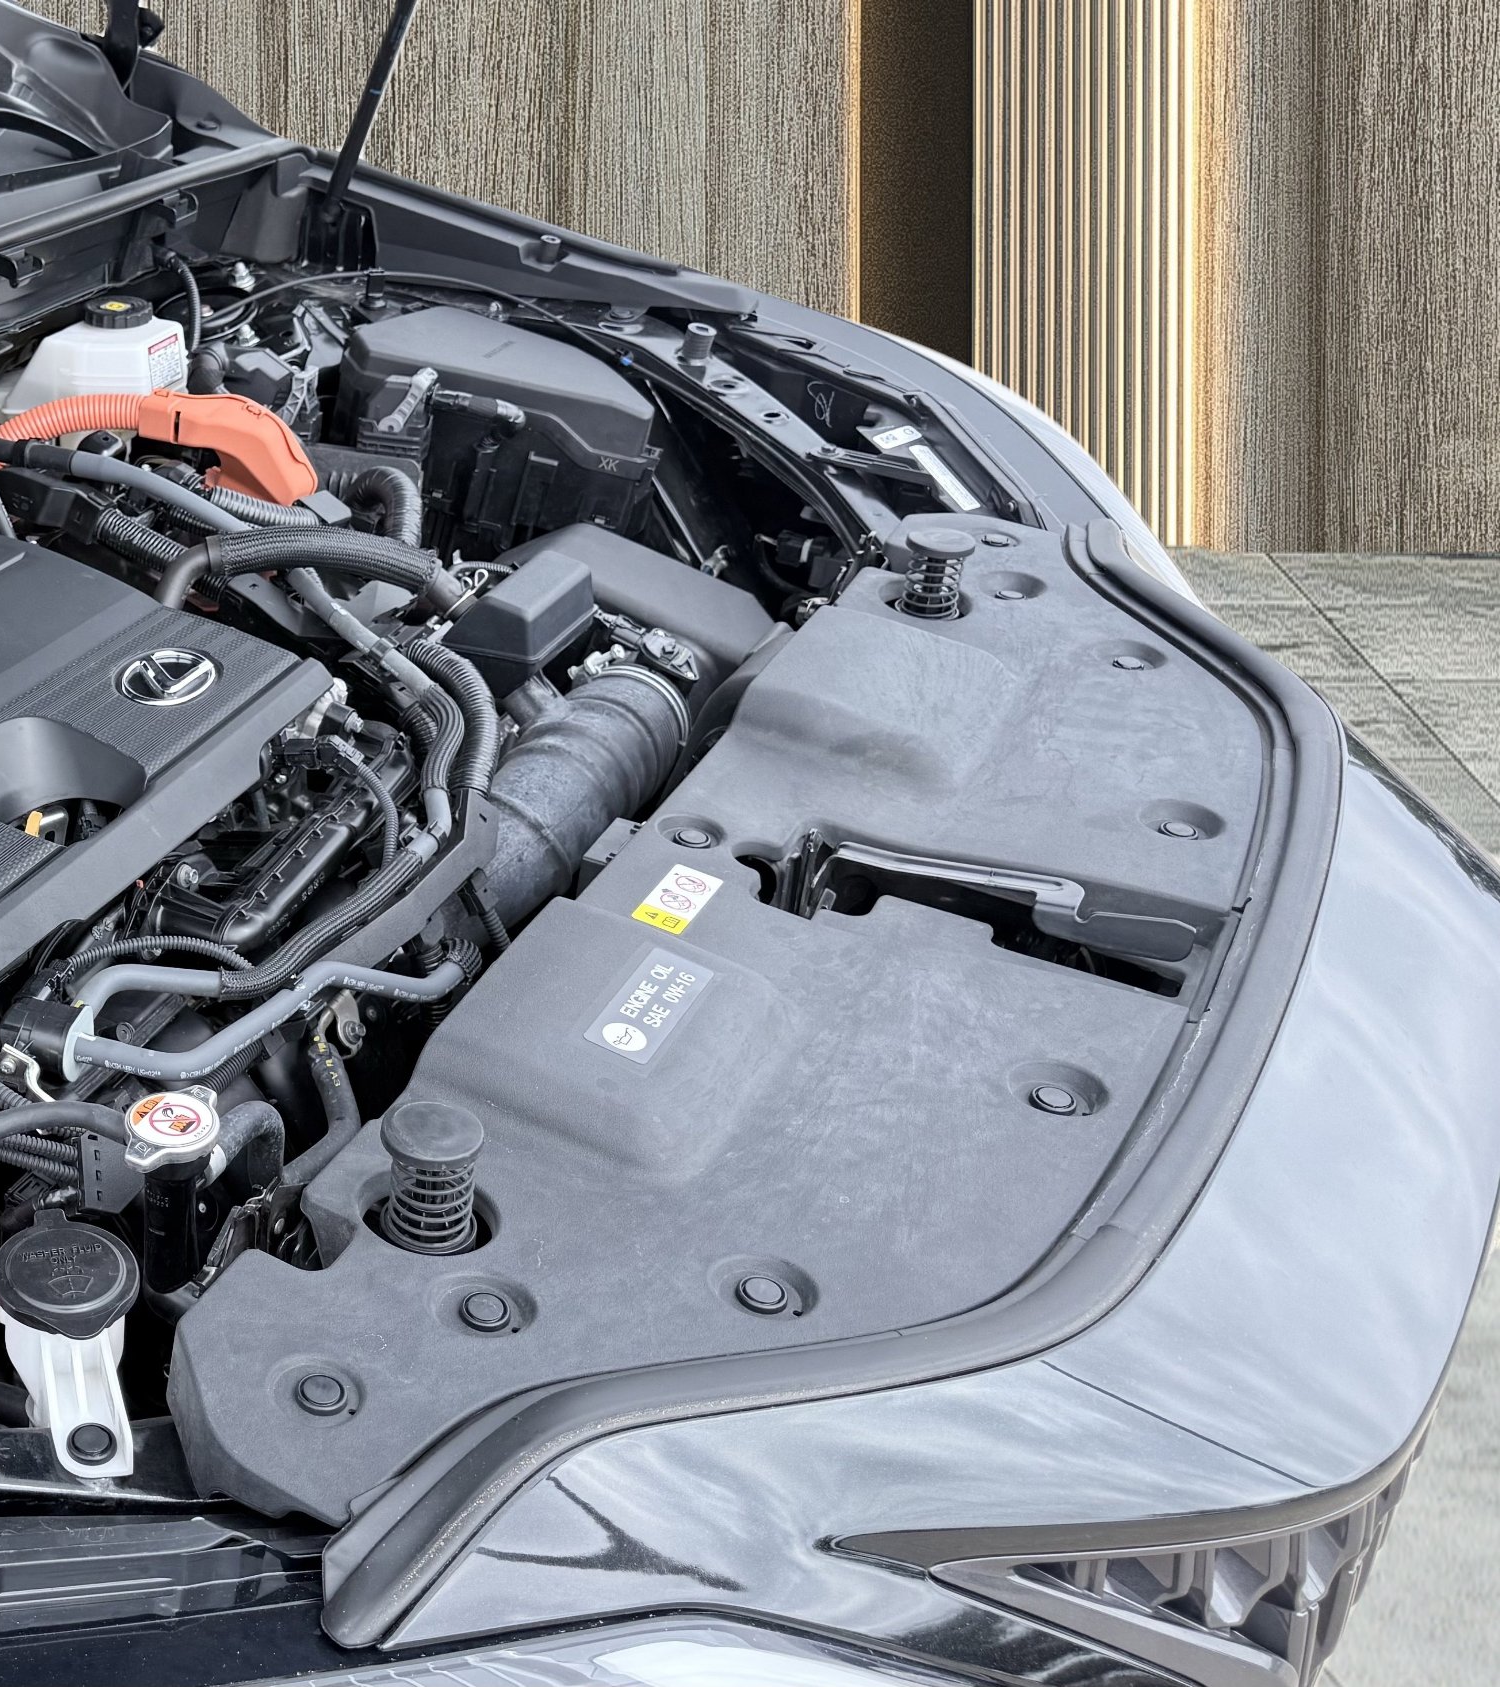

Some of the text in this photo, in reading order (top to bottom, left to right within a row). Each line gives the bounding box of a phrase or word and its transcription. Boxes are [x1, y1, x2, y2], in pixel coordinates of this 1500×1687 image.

[598, 456, 619, 472] XK
[619, 963, 675, 1019] ENGINE OIL
[643, 971, 696, 1028] SAE 0W-16
[20, 1243, 102, 1263] WASHER FLUID
[50, 1255, 77, 1265] ONLY
